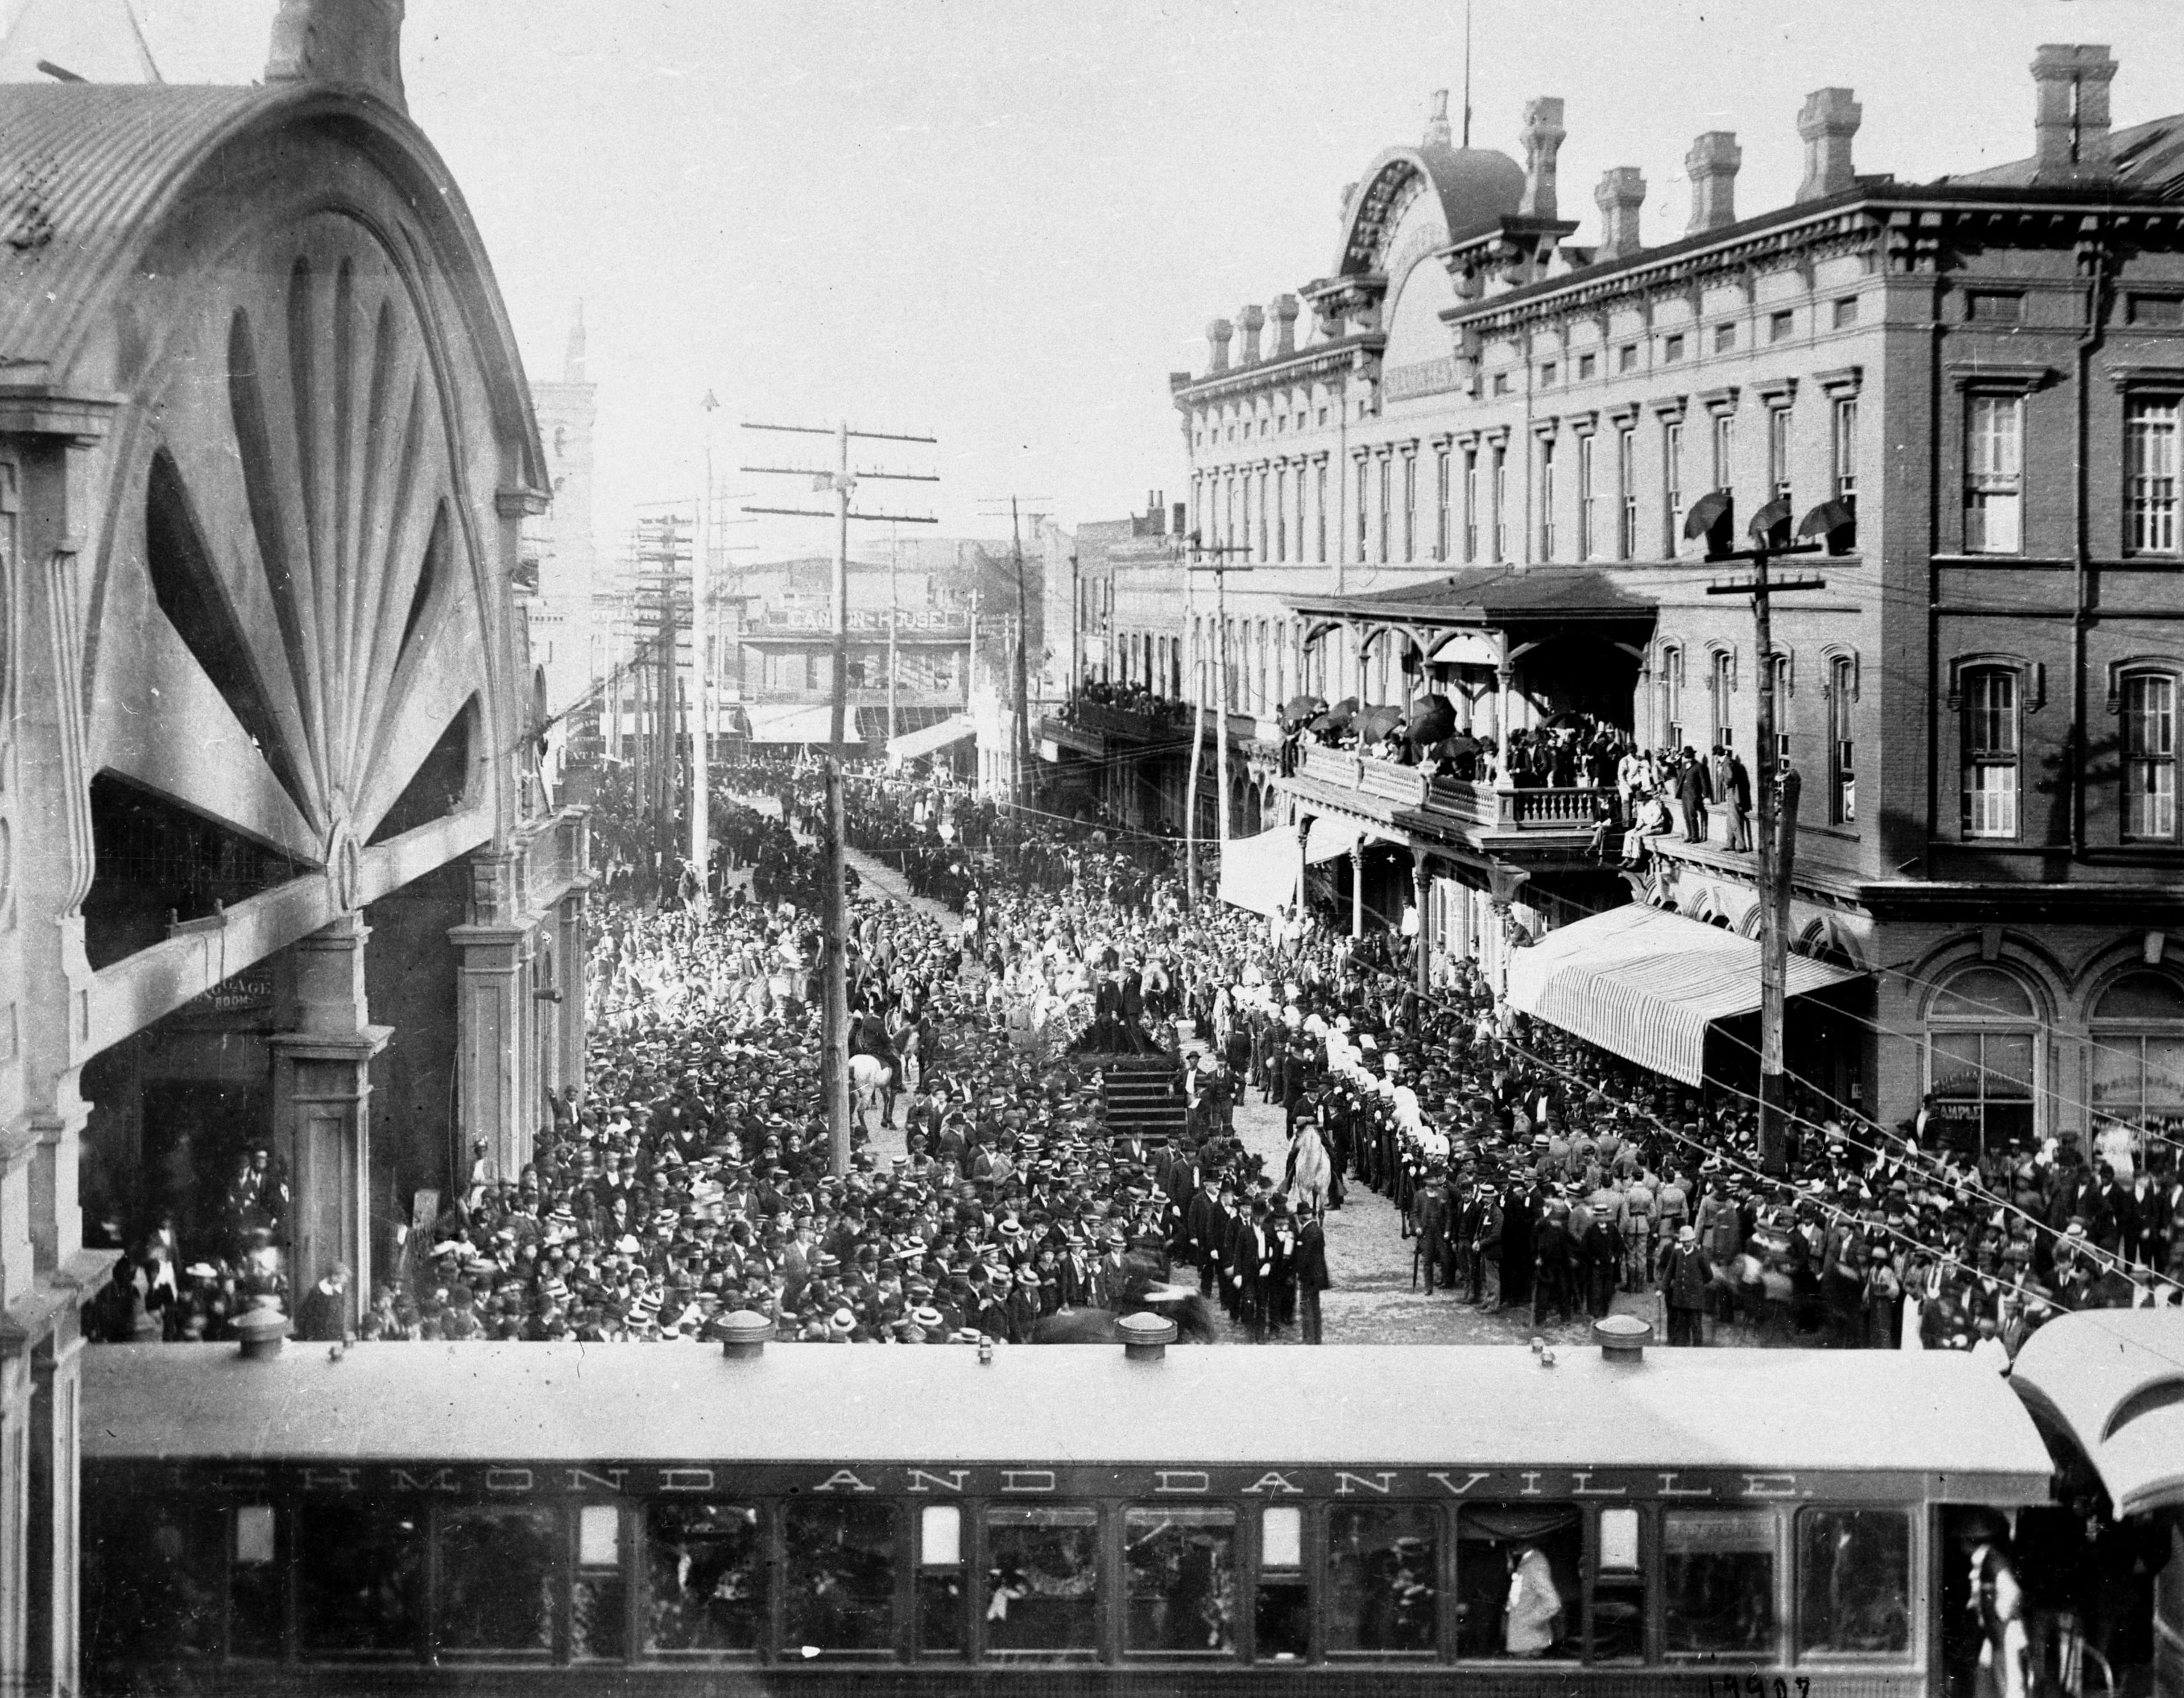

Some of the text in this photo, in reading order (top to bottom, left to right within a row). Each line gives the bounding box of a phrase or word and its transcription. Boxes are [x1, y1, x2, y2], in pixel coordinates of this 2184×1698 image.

[196, 978, 271, 1001] AGGAGE
[1932, 1104, 1982, 1121] AMPLE
[813, 1469, 1055, 1492] AND
